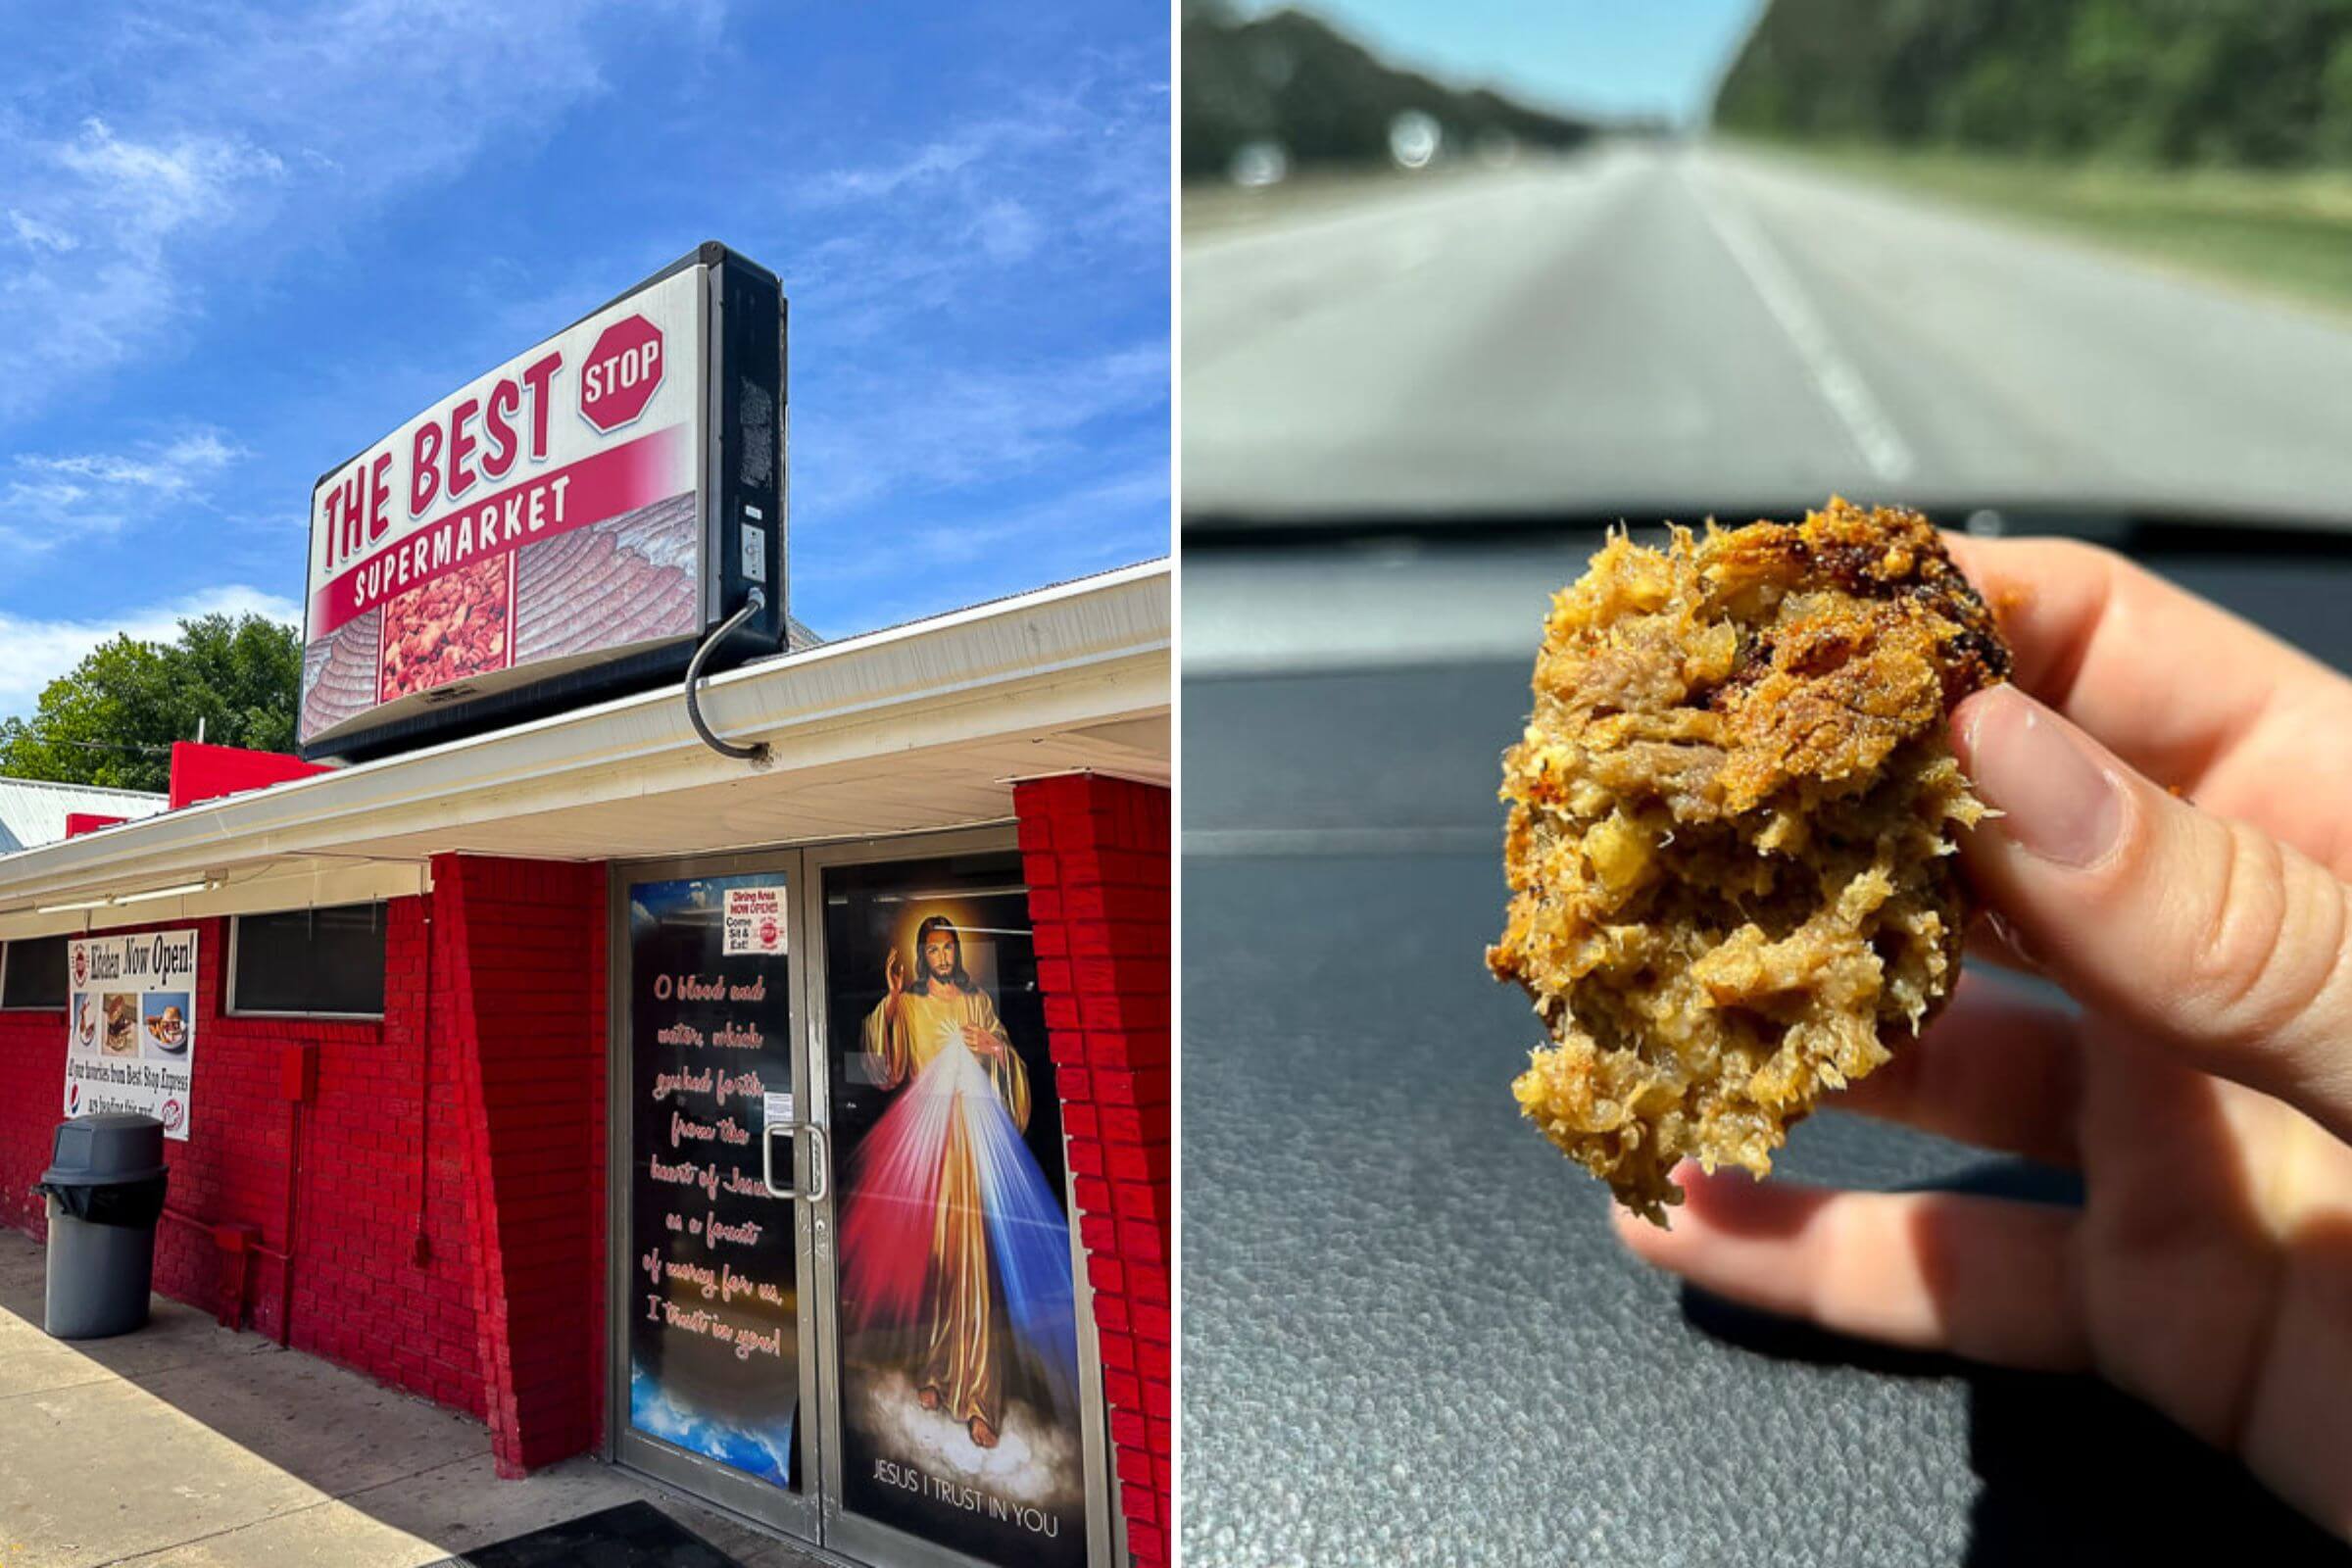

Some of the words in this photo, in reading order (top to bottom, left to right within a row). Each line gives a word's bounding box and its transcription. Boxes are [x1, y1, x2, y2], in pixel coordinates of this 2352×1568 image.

[323, 451, 392, 568] THE
[410, 350, 563, 516] BEST
[585, 339, 660, 404] STOP
[354, 475, 570, 608] SUPERMARKET
[730, 904, 749, 914] NOW
[732, 892, 757, 905] Dining
[758, 891, 776, 900] Area
[726, 916, 752, 927] Come
[728, 928, 741, 939] Sit
[742, 927, 750, 938] &
[91, 944, 120, 979] Kitchen
[122, 936, 150, 974] Now
[152, 932, 194, 986] Open!
[654, 974, 672, 1000] O
[677, 974, 725, 1001] blood
[730, 974, 765, 1001] and
[712, 1021, 763, 1049] which
[111, 1063, 126, 1085] from
[126, 1064, 143, 1087] Best
[143, 1065, 160, 1095] Stop
[161, 1067, 189, 1096] Express
[652, 1065, 713, 1101] gushed
[716, 1068, 764, 1105] forth
[671, 1111, 715, 1148] from
[716, 1116, 750, 1146] the
[651, 1153, 699, 1184] heart
[699, 1163, 719, 1200] of
[666, 1212, 683, 1232] as
[689, 1217, 703, 1234] a
[707, 1211, 762, 1250] fount
[642, 1248, 662, 1285] of
[666, 1262, 719, 1298] mercy
[722, 1263, 753, 1301] for
[758, 1283, 783, 1306] us,
[647, 1294, 662, 1321] I
[662, 1300, 712, 1334] trust
[711, 1313, 733, 1342] in
[734, 1328, 781, 1360] you!
[872, 1458, 919, 1493] JESUS
[923, 1475, 929, 1495] I
[933, 1477, 982, 1512] TRUST
[989, 1495, 1007, 1523] IN
[1010, 1502, 1059, 1539] YOU
